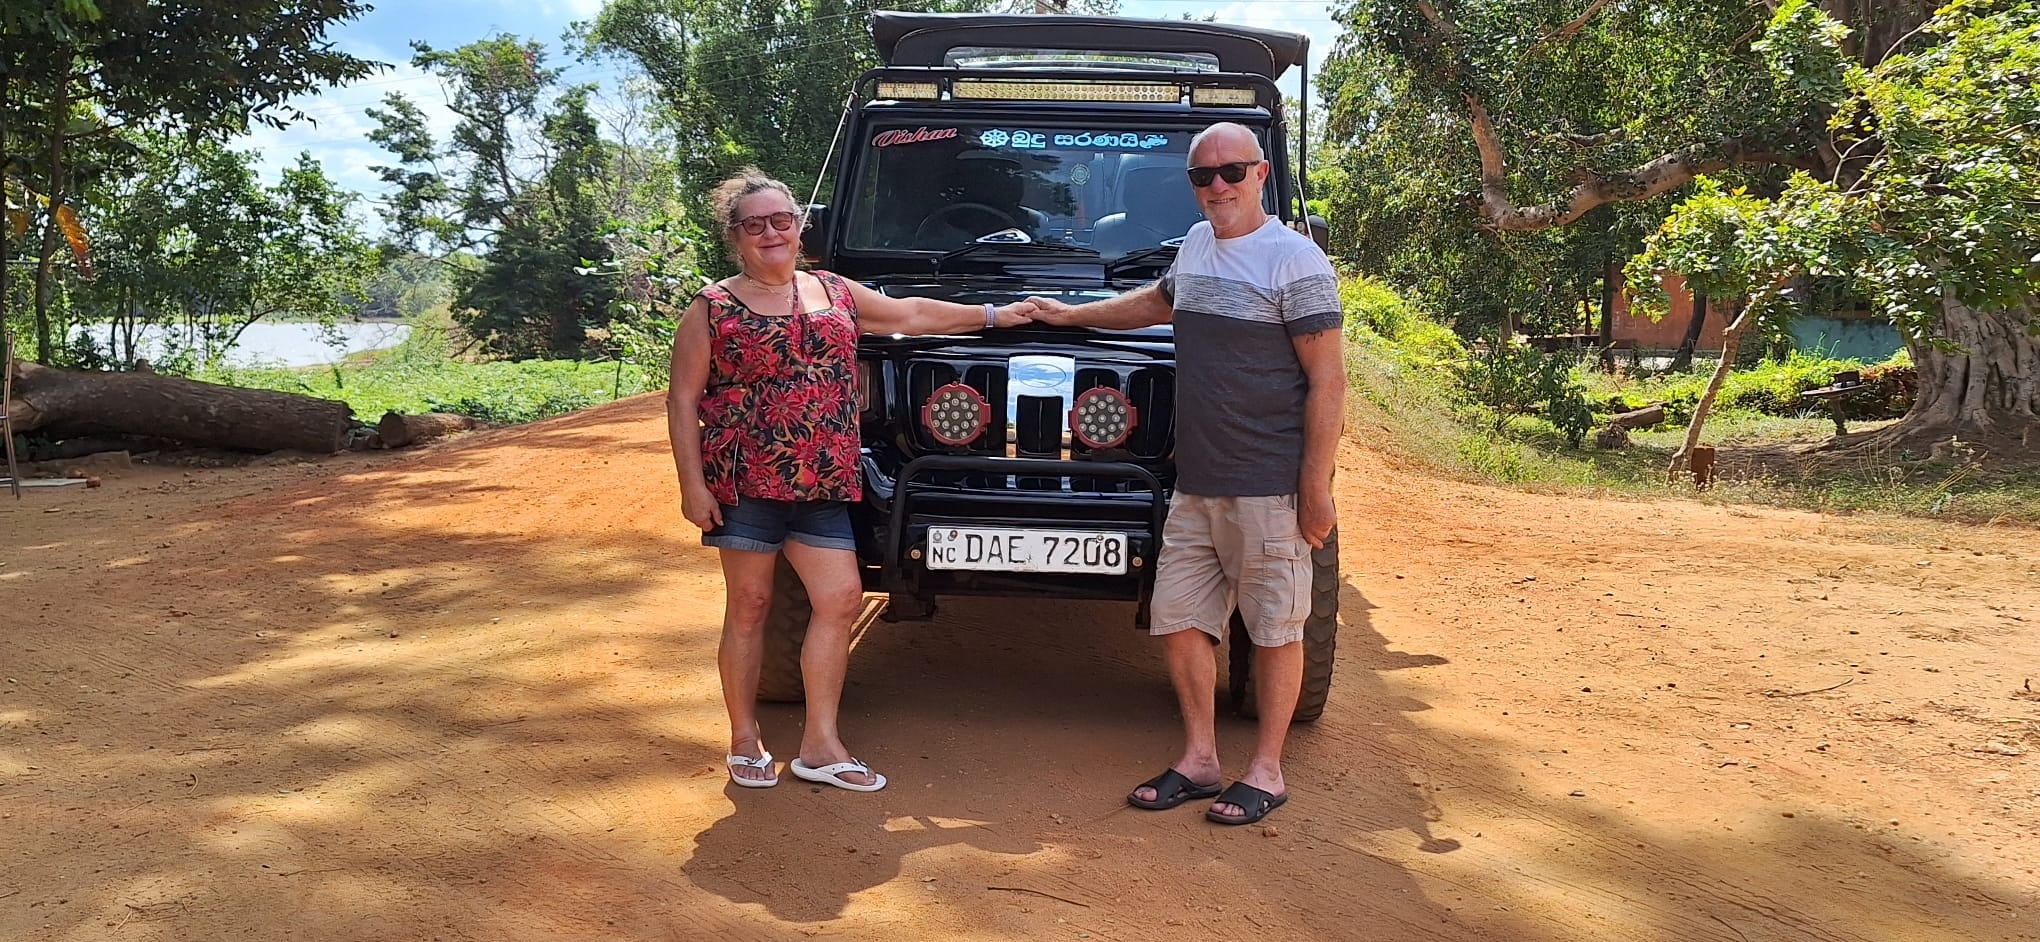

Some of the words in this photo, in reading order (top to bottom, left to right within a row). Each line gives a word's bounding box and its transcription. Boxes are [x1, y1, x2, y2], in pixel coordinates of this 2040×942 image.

[1011, 130, 1046, 149] බුදු
[1054, 132, 1139, 148] සරණයි
[932, 546, 956, 564] NC
[965, 533, 1025, 564] DAE
[1043, 536, 1121, 568] 7208
